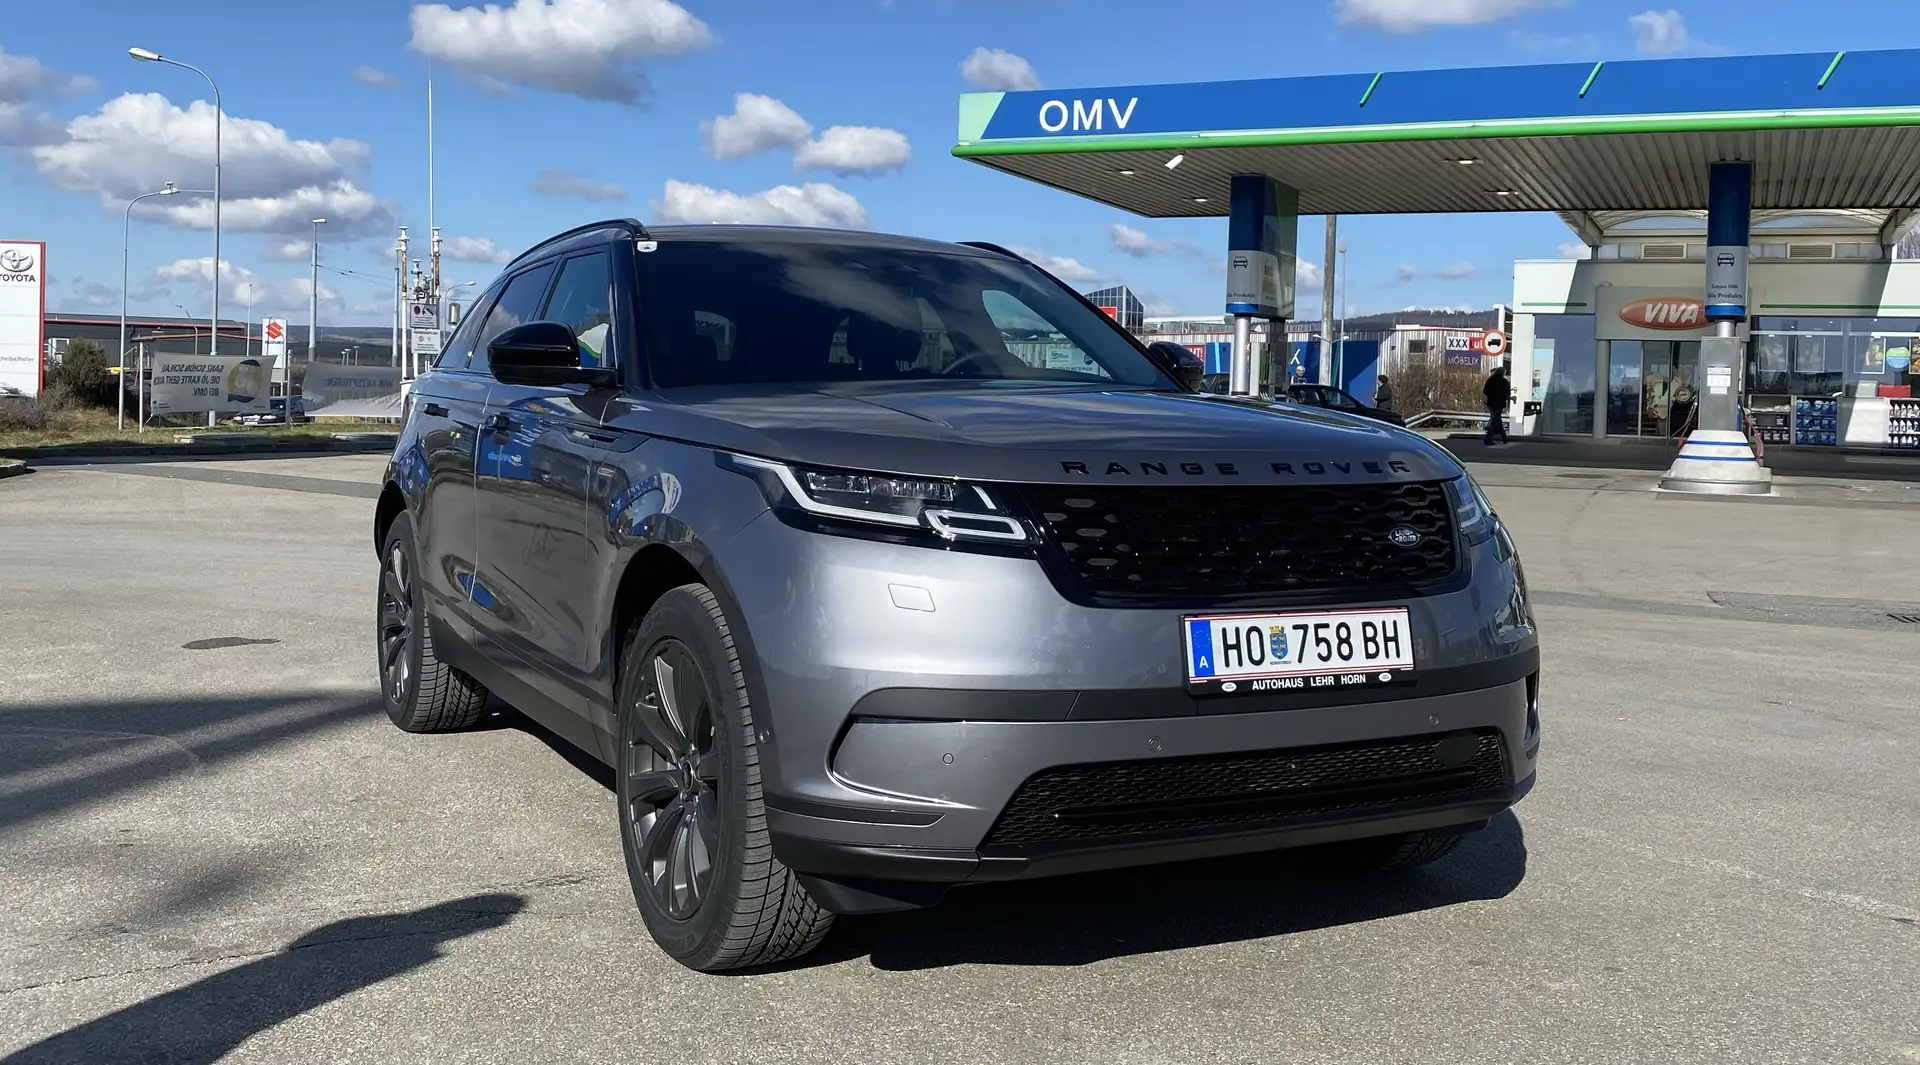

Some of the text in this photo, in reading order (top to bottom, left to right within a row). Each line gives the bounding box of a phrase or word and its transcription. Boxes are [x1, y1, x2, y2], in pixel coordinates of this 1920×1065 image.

[1039, 97, 1139, 132] OMV
[1644, 302, 1700, 323] VIVA
[1060, 460, 1411, 475] RANGE ROVER
[1199, 619, 1401, 669] A HO 758 BH
[1252, 677, 1304, 691] AUTOHAUS
[1310, 674, 1335, 687] LEHR
[1341, 673, 1366, 684] HORN
